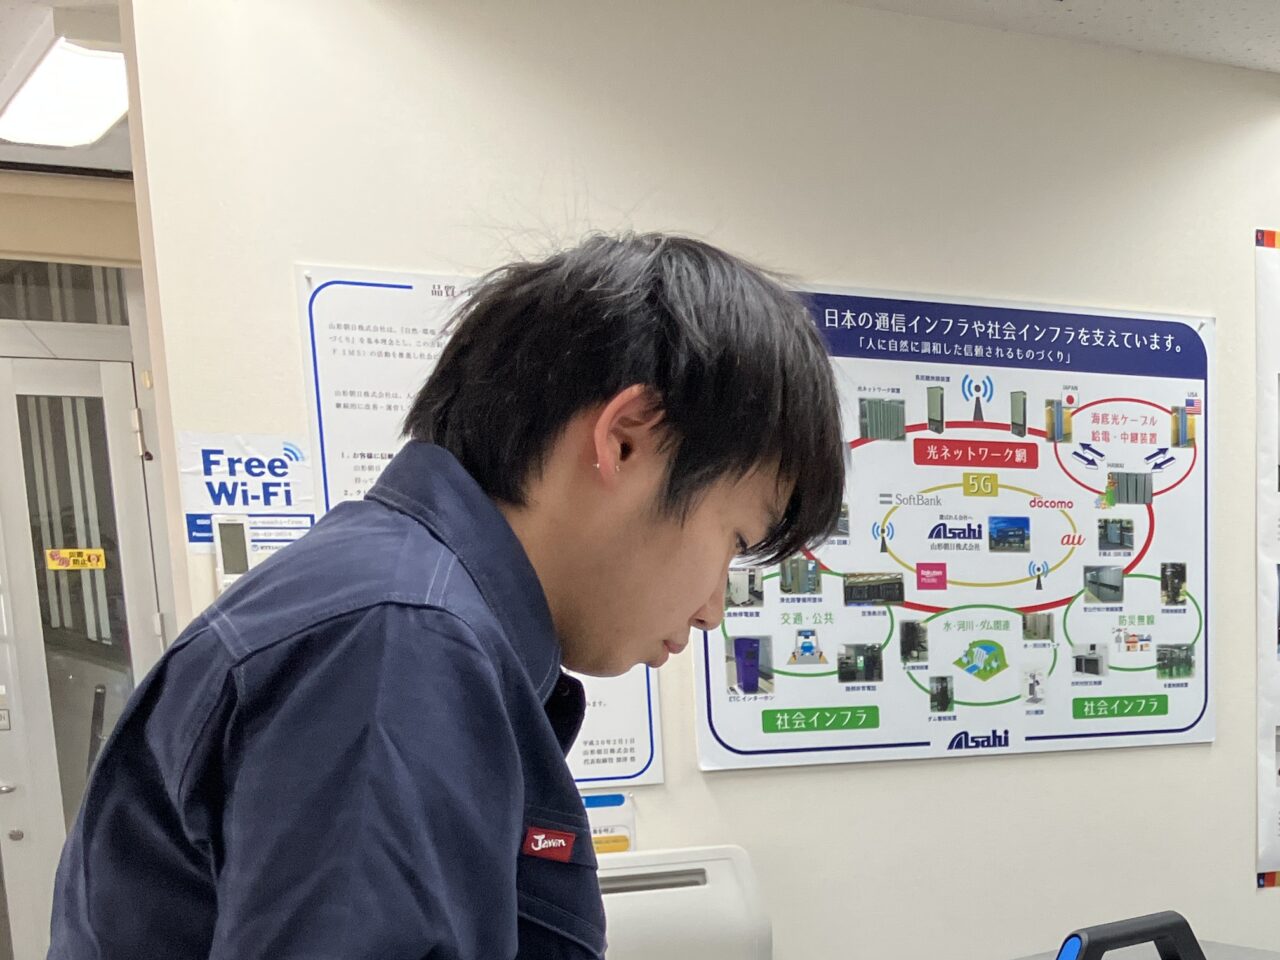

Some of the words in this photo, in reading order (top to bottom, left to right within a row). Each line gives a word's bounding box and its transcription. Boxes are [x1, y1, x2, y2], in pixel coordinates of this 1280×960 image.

[825, 308, 1182, 353] 日本の通信インフラや社会インフラを支えています。
[858, 336, 1072, 364] 「人に自然に調和した信頼されるものづくり」
[1091, 412, 1158, 427] 海底光ケーブル
[201, 449, 289, 477] Free
[926, 445, 1028, 463] 光ネットワーク網
[205, 481, 292, 506] Wi-Fi
[969, 475, 992, 494] 5G
[895, 494, 942, 506] SoftBank
[1029, 497, 1074, 509] docomo
[928, 522, 983, 540] Asahi
[1060, 533, 1086, 546] au
[780, 612, 834, 625] 交通・公共
[1118, 614, 1155, 626] 防災無線
[1083, 698, 1158, 717] 社会インフラ
[776, 709, 867, 730] 社会インフラ
[947, 729, 1010, 750] Asahi
